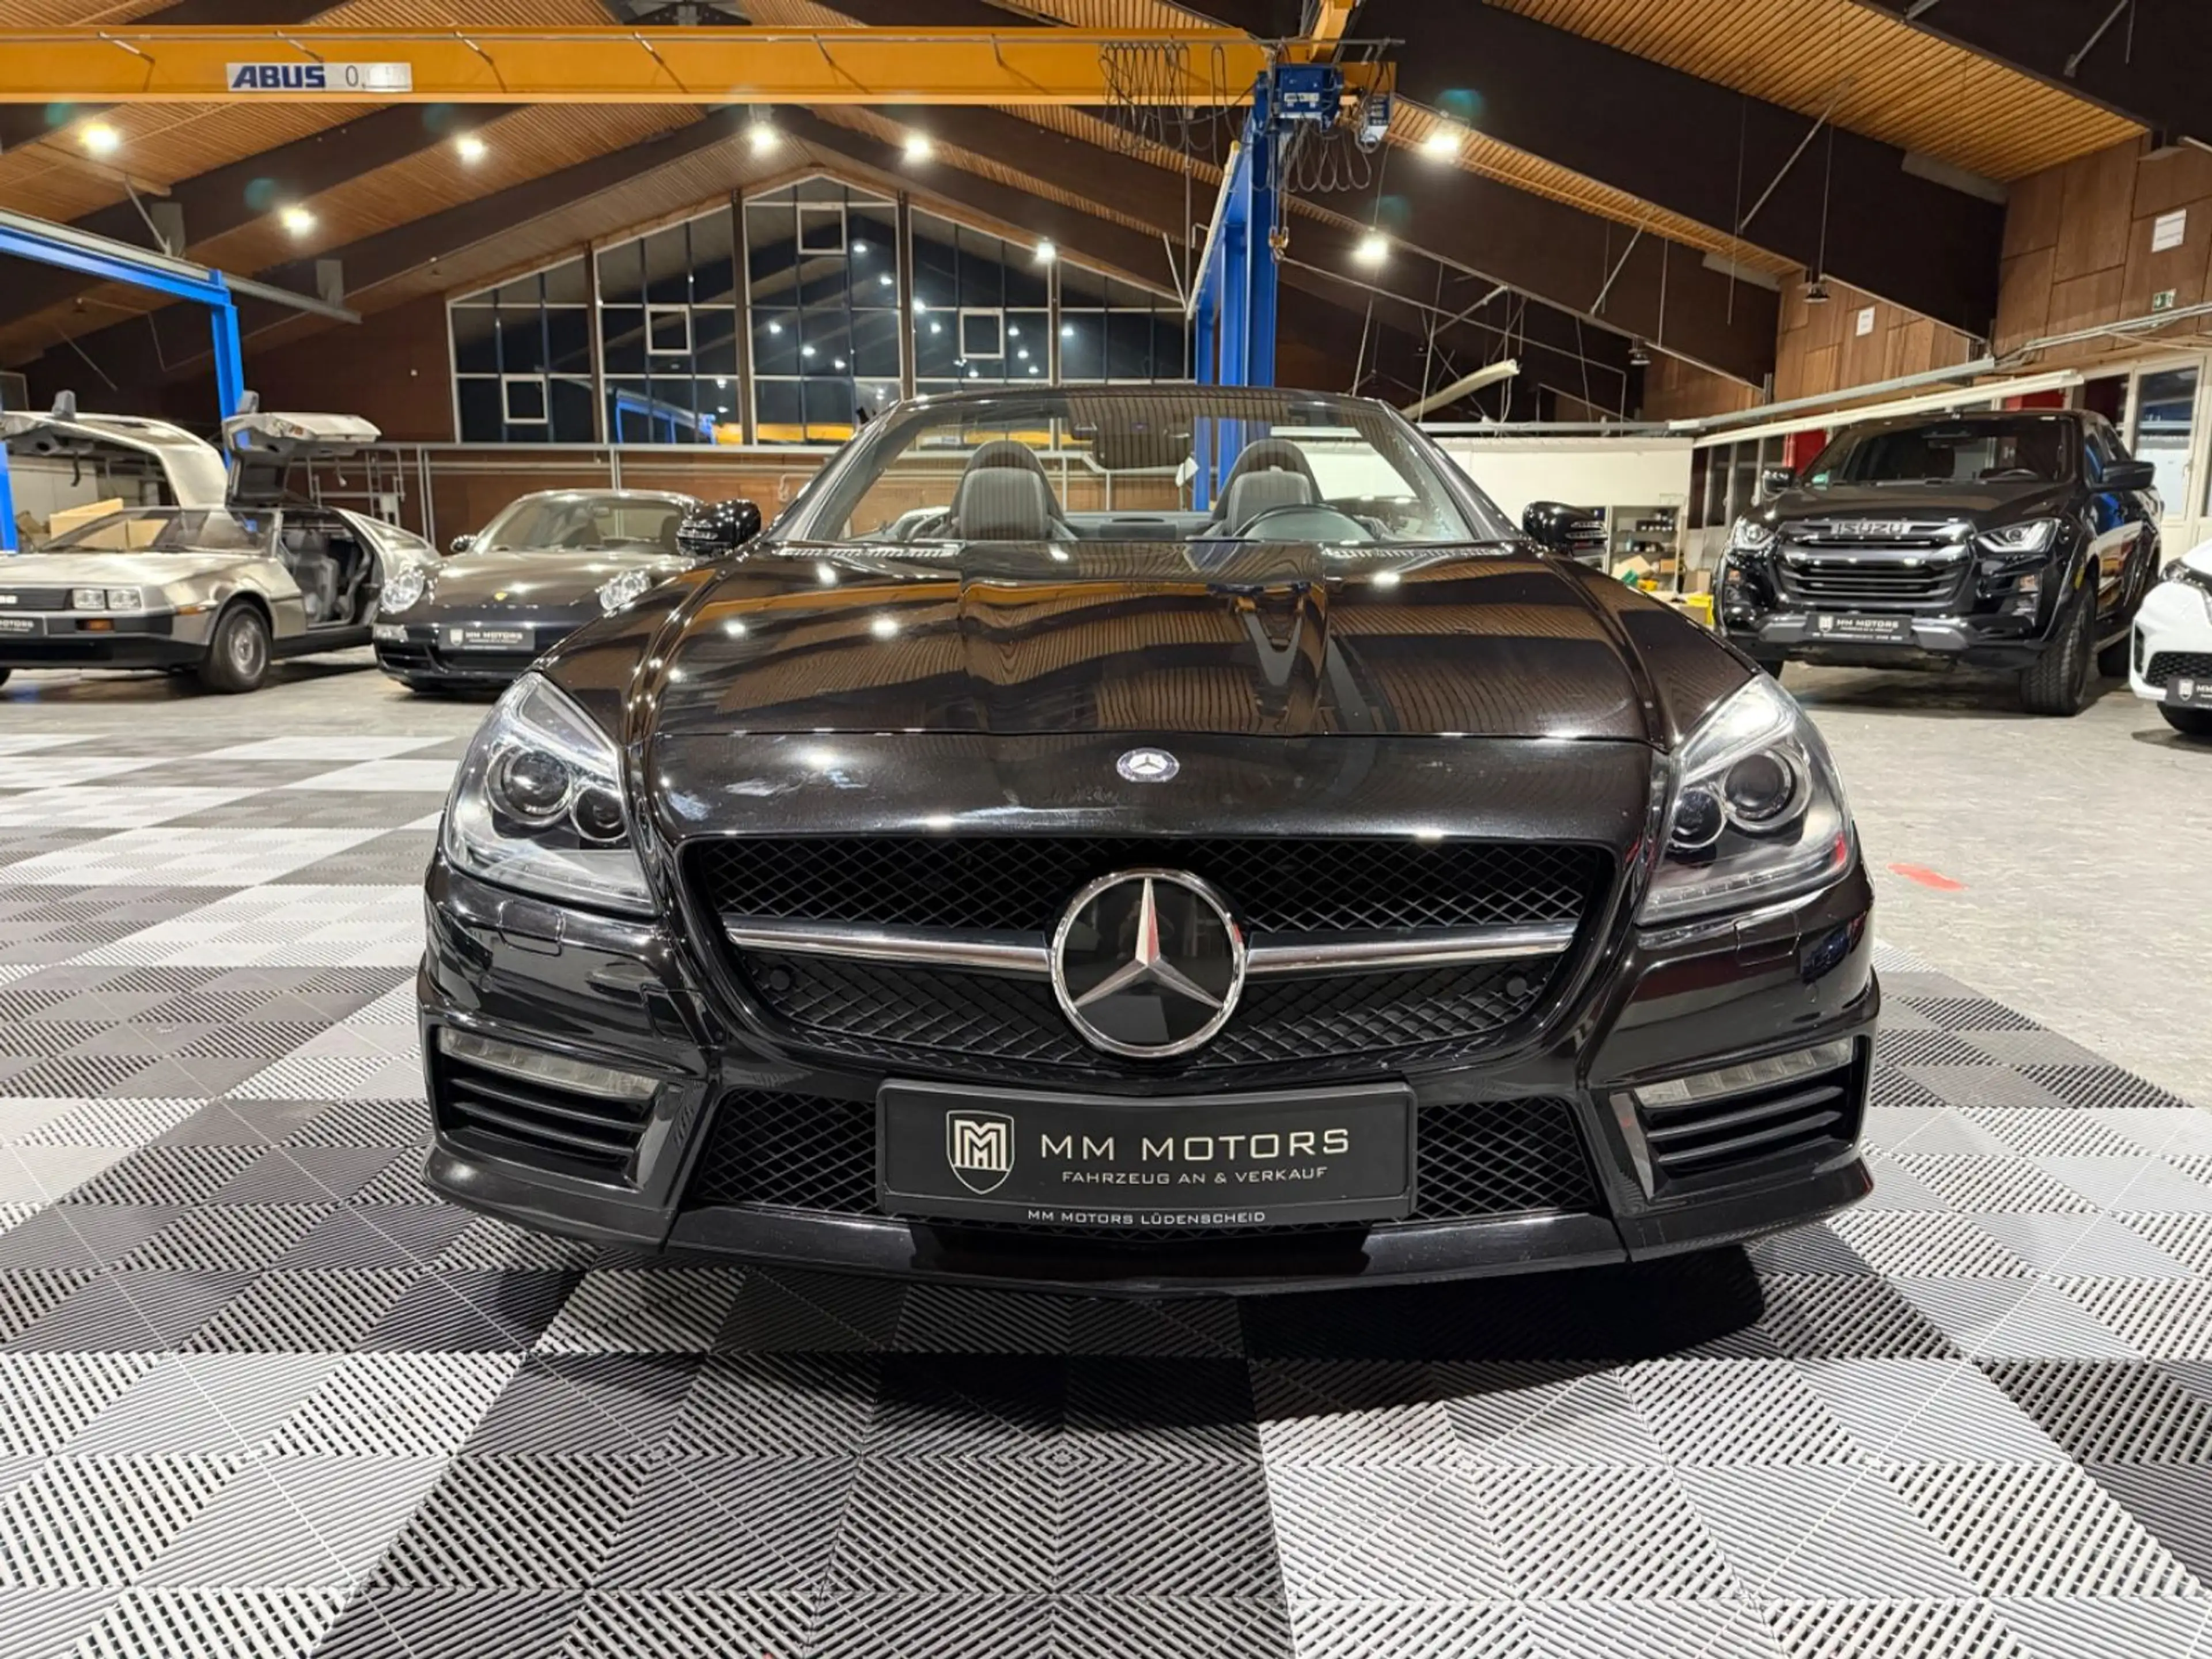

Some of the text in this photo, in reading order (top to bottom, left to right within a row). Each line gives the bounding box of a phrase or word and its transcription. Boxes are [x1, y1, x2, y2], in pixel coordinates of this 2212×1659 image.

[232, 65, 325, 88] ABUS
[1838, 521, 1903, 534] ISUZU
[1855, 619, 1899, 628] MOTORS
[1041, 1128, 1349, 1161] MM MOTORS
[1062, 1166, 1328, 1185] FAHRZEUG AN & VERKAUF
[1028, 1209, 1266, 1225] MM MOTORS LÜDENSCHEID
